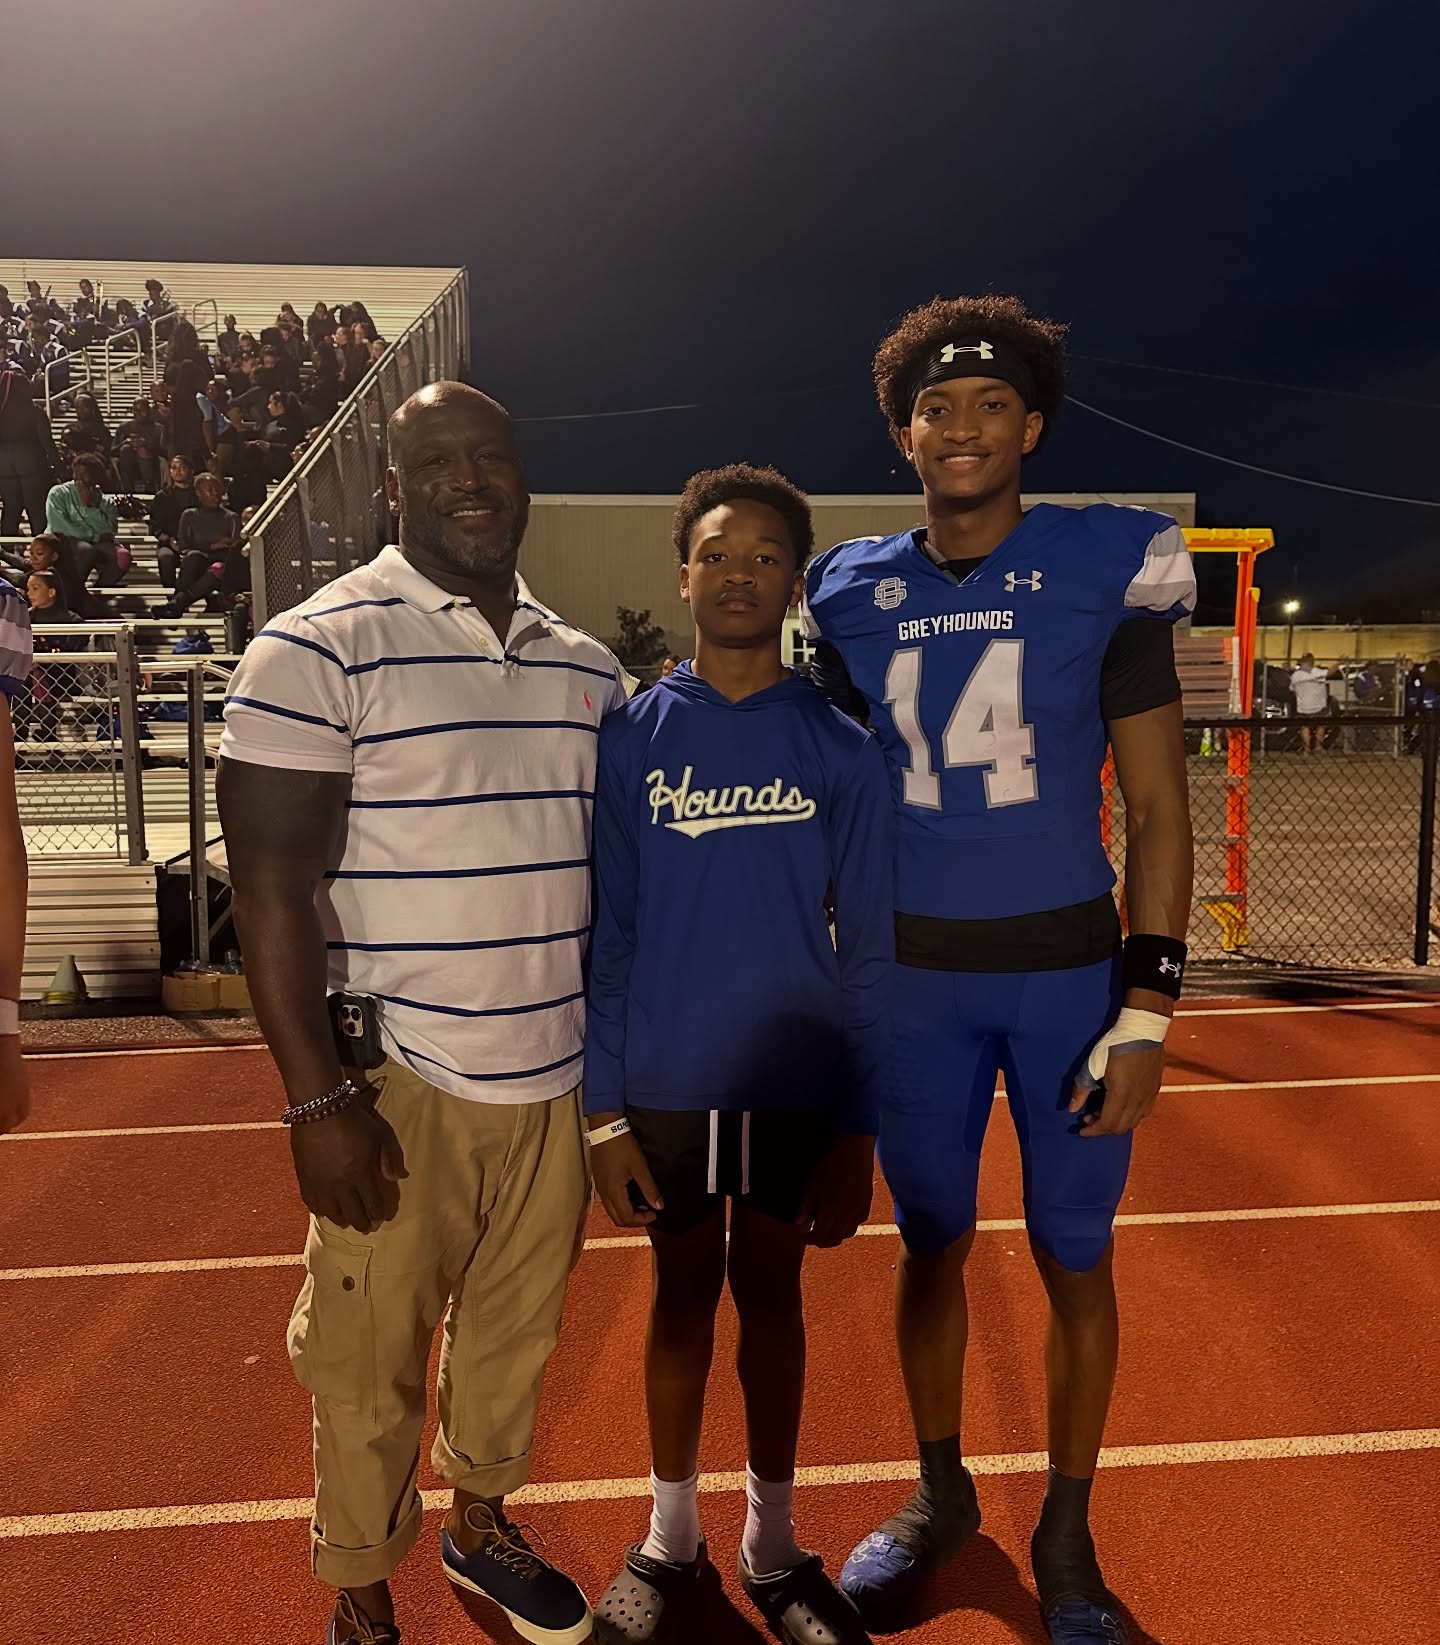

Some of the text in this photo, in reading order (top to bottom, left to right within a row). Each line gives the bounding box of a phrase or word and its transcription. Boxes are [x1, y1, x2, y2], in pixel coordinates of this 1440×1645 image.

[898, 610, 1014, 641] GREYHOUNDS
[882, 638, 1040, 812] 14
[645, 765, 814, 826] Hounds
